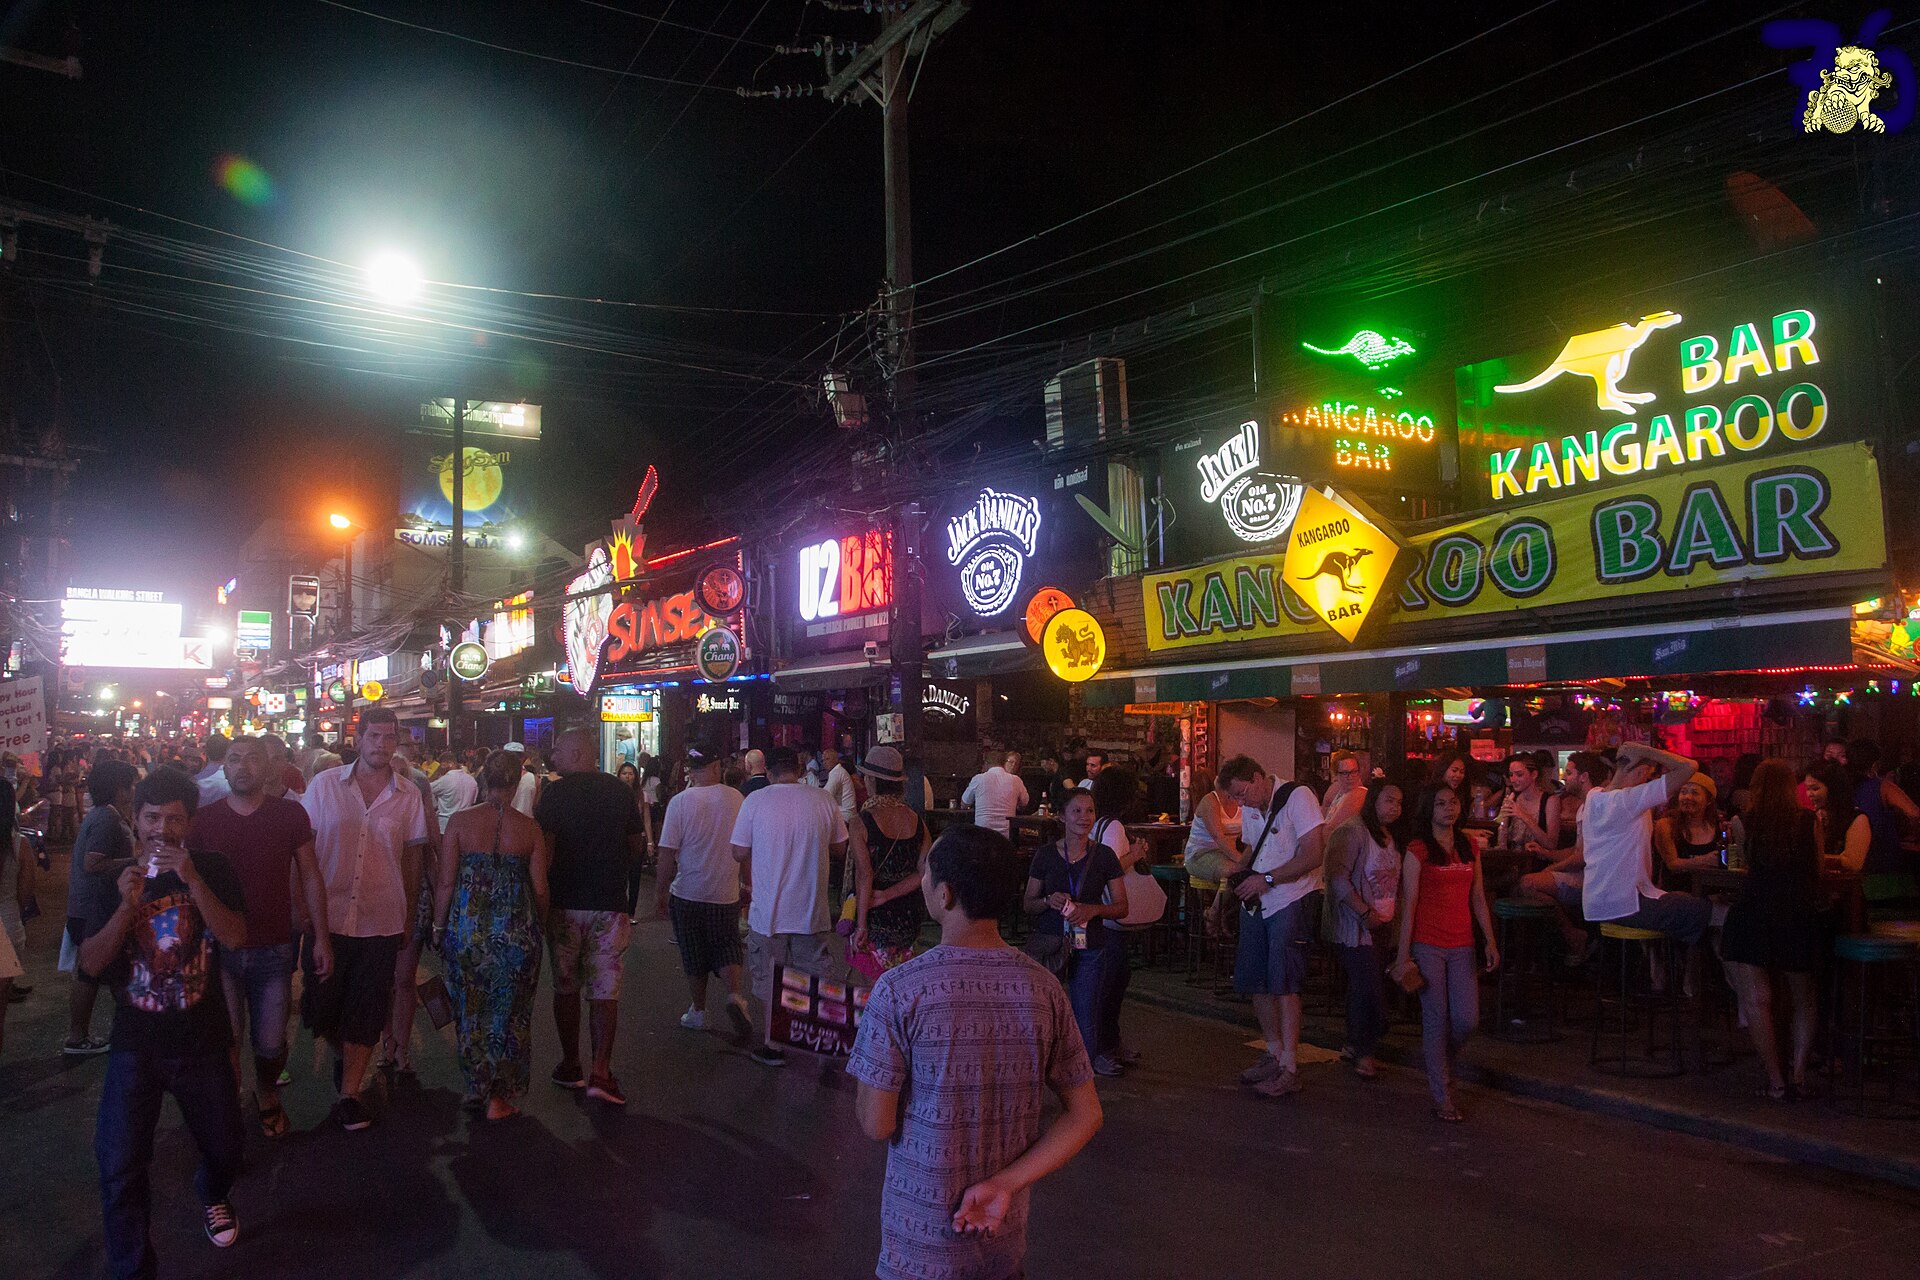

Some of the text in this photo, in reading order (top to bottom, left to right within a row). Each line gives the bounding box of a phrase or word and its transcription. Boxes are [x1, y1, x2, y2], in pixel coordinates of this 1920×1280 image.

[1680, 309, 1820, 394] BAR
[1489, 382, 1828, 500] KANGAROO
[1336, 439, 1391, 470] BAR
[1200, 432, 1244, 500] JACK
[1248, 484, 1267, 497] Old
[948, 506, 980, 561] JACK
[1296, 518, 1350, 548] KANGAROO
[1591, 466, 1840, 585] BAR
[400, 532, 470, 549] SOMSK
[981, 561, 995, 573] Old
[67, 587, 164, 602] BANGLA WALKING STREET
[1327, 603, 1362, 622] BAR
[704, 651, 735, 662] Chang
[456, 660, 485, 672] Chang
[15, 687, 37, 698] Hour
[5, 711, 41, 729] 1 Get 1
[602, 712, 652, 720] PHARMACY
